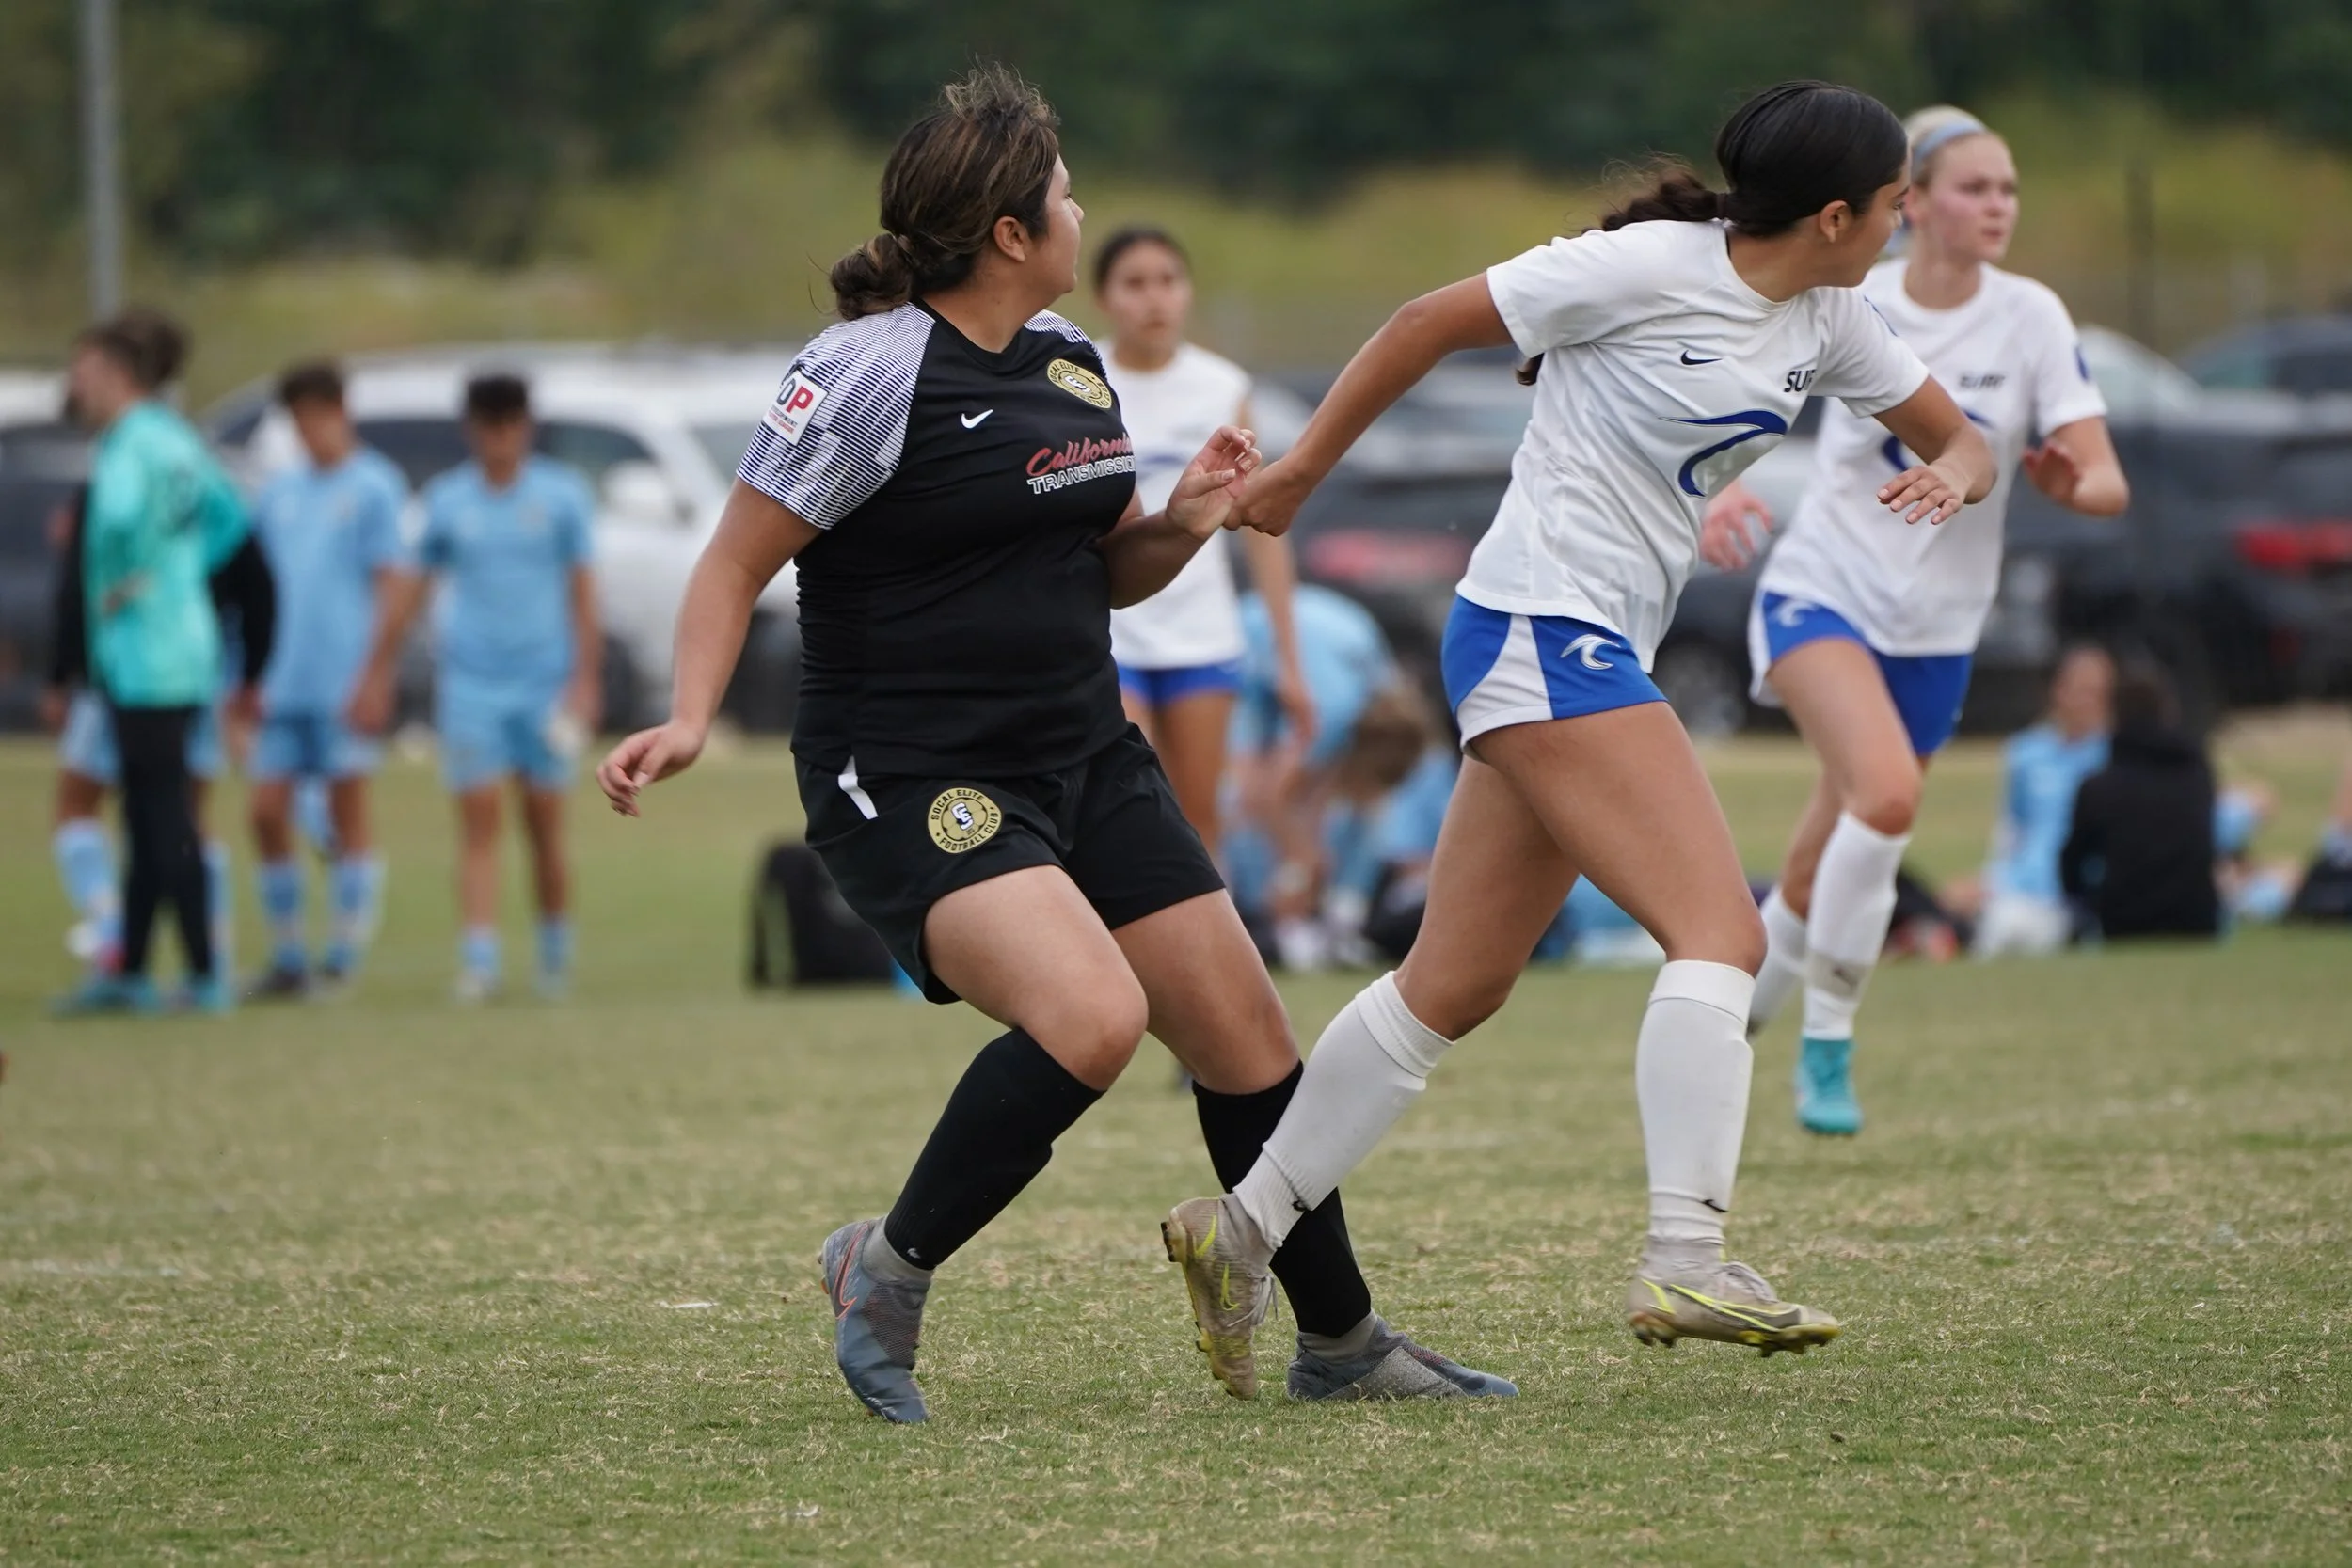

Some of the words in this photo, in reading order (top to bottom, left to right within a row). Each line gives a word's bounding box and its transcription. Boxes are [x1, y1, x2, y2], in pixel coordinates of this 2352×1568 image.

[930, 792, 955, 820] SOCAL
[956, 789, 985, 801] ELITE
[940, 833, 986, 851] FOOTBALL
[984, 812, 999, 834] CLUB
